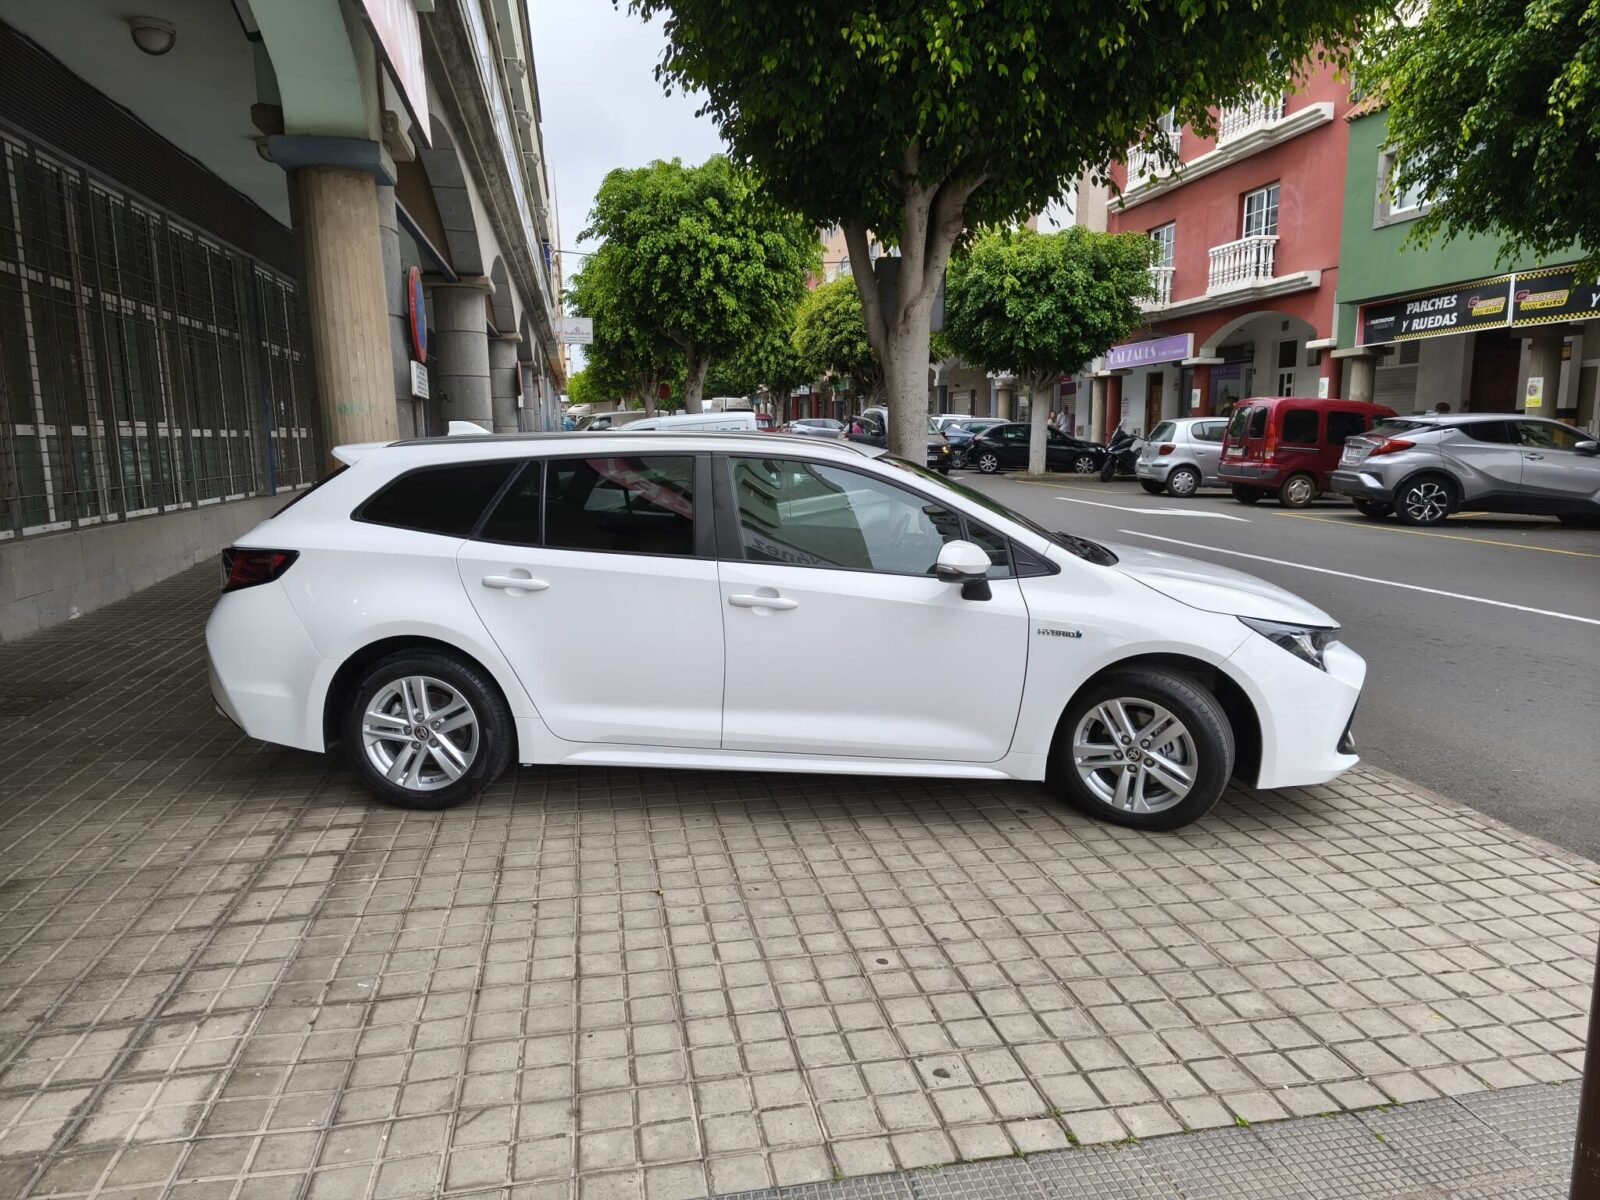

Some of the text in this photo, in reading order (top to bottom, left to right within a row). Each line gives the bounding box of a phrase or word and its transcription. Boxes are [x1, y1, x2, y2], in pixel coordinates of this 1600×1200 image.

[1406, 294, 1458, 315] PARCHES
[1539, 299, 1564, 307] auto
[1401, 320, 1409, 333] Y
[1411, 312, 1458, 331] RUEDAS
[1038, 628, 1075, 638] HYBRID
